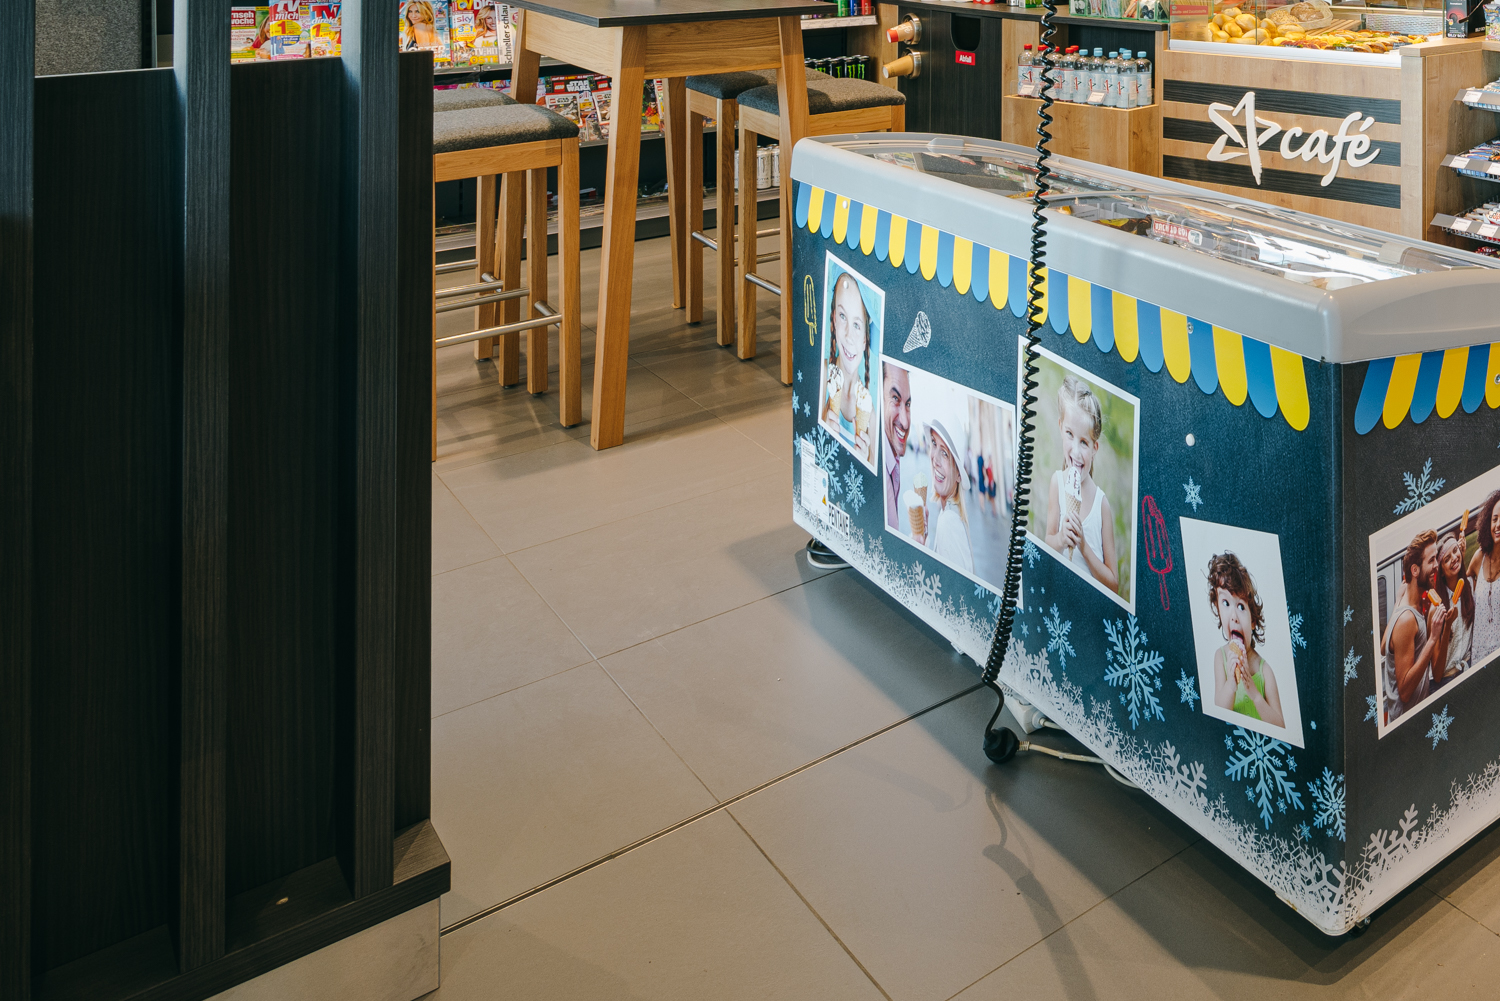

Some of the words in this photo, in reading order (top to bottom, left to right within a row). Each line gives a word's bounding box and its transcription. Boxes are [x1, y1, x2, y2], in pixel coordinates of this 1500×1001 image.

[277, 0, 299, 12] TV
[275, 12, 299, 21] mich
[456, 15, 473, 24] sky
[959, 54, 972, 63] Abfall
[1280, 111, 1381, 187] café
[828, 503, 849, 538] PENTANE
